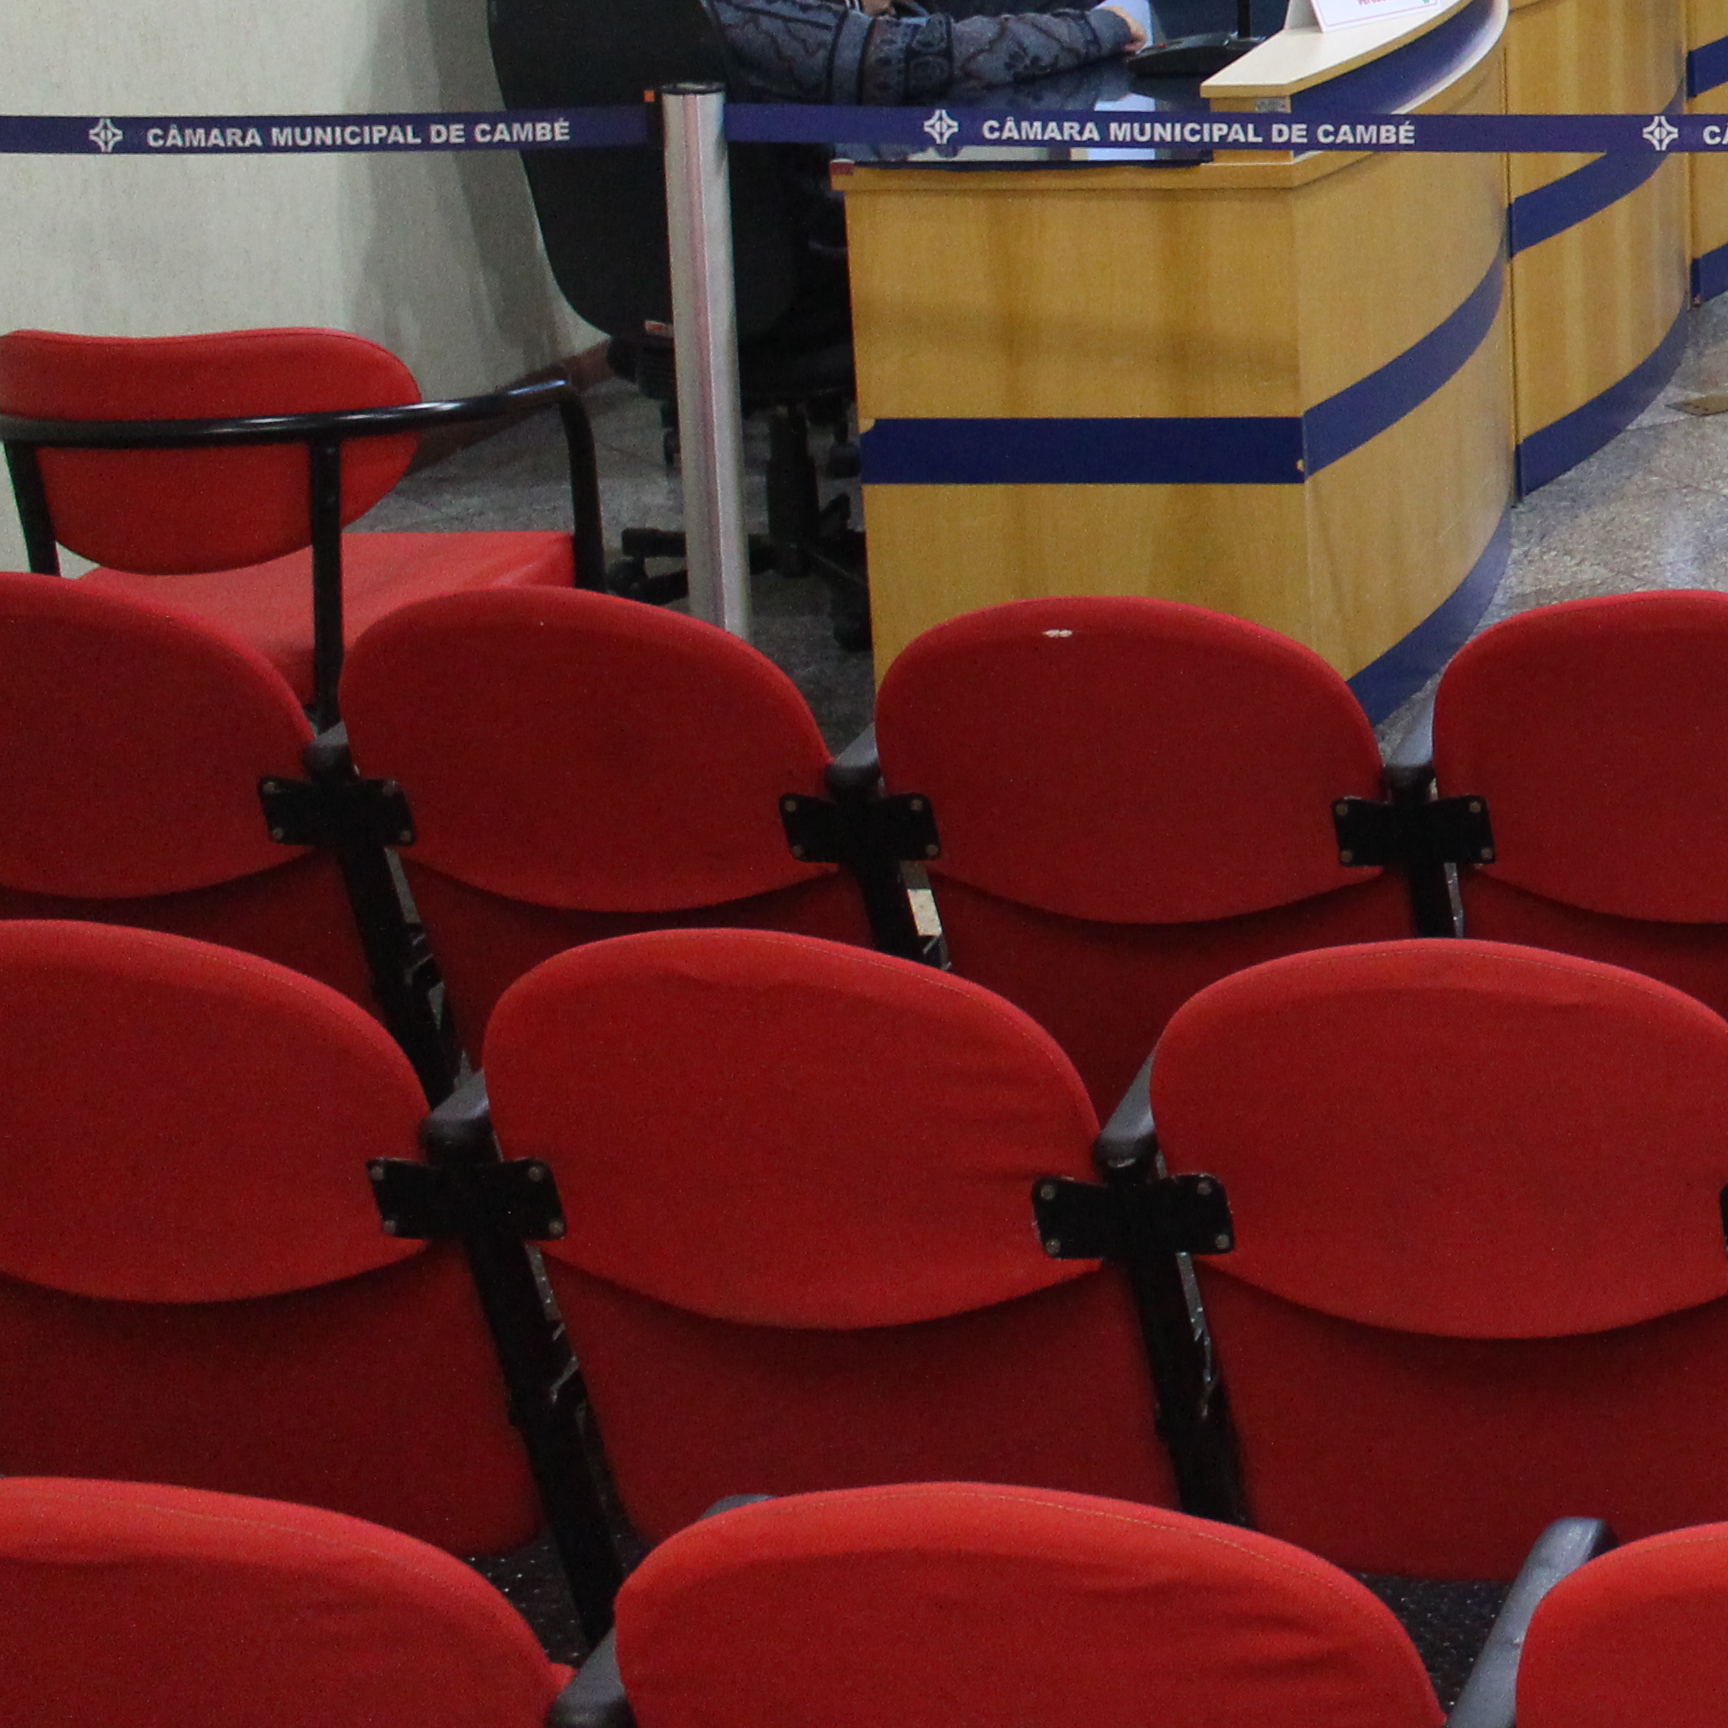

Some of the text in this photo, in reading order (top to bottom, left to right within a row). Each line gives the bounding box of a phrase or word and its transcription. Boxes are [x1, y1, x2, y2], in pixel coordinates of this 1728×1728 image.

[146, 116, 571, 148] CÂMARA MUNICIPAL DE CAMBÉ
[981, 115, 1416, 146] CÂMARA MUNICIPAL DE CAMBÉ
